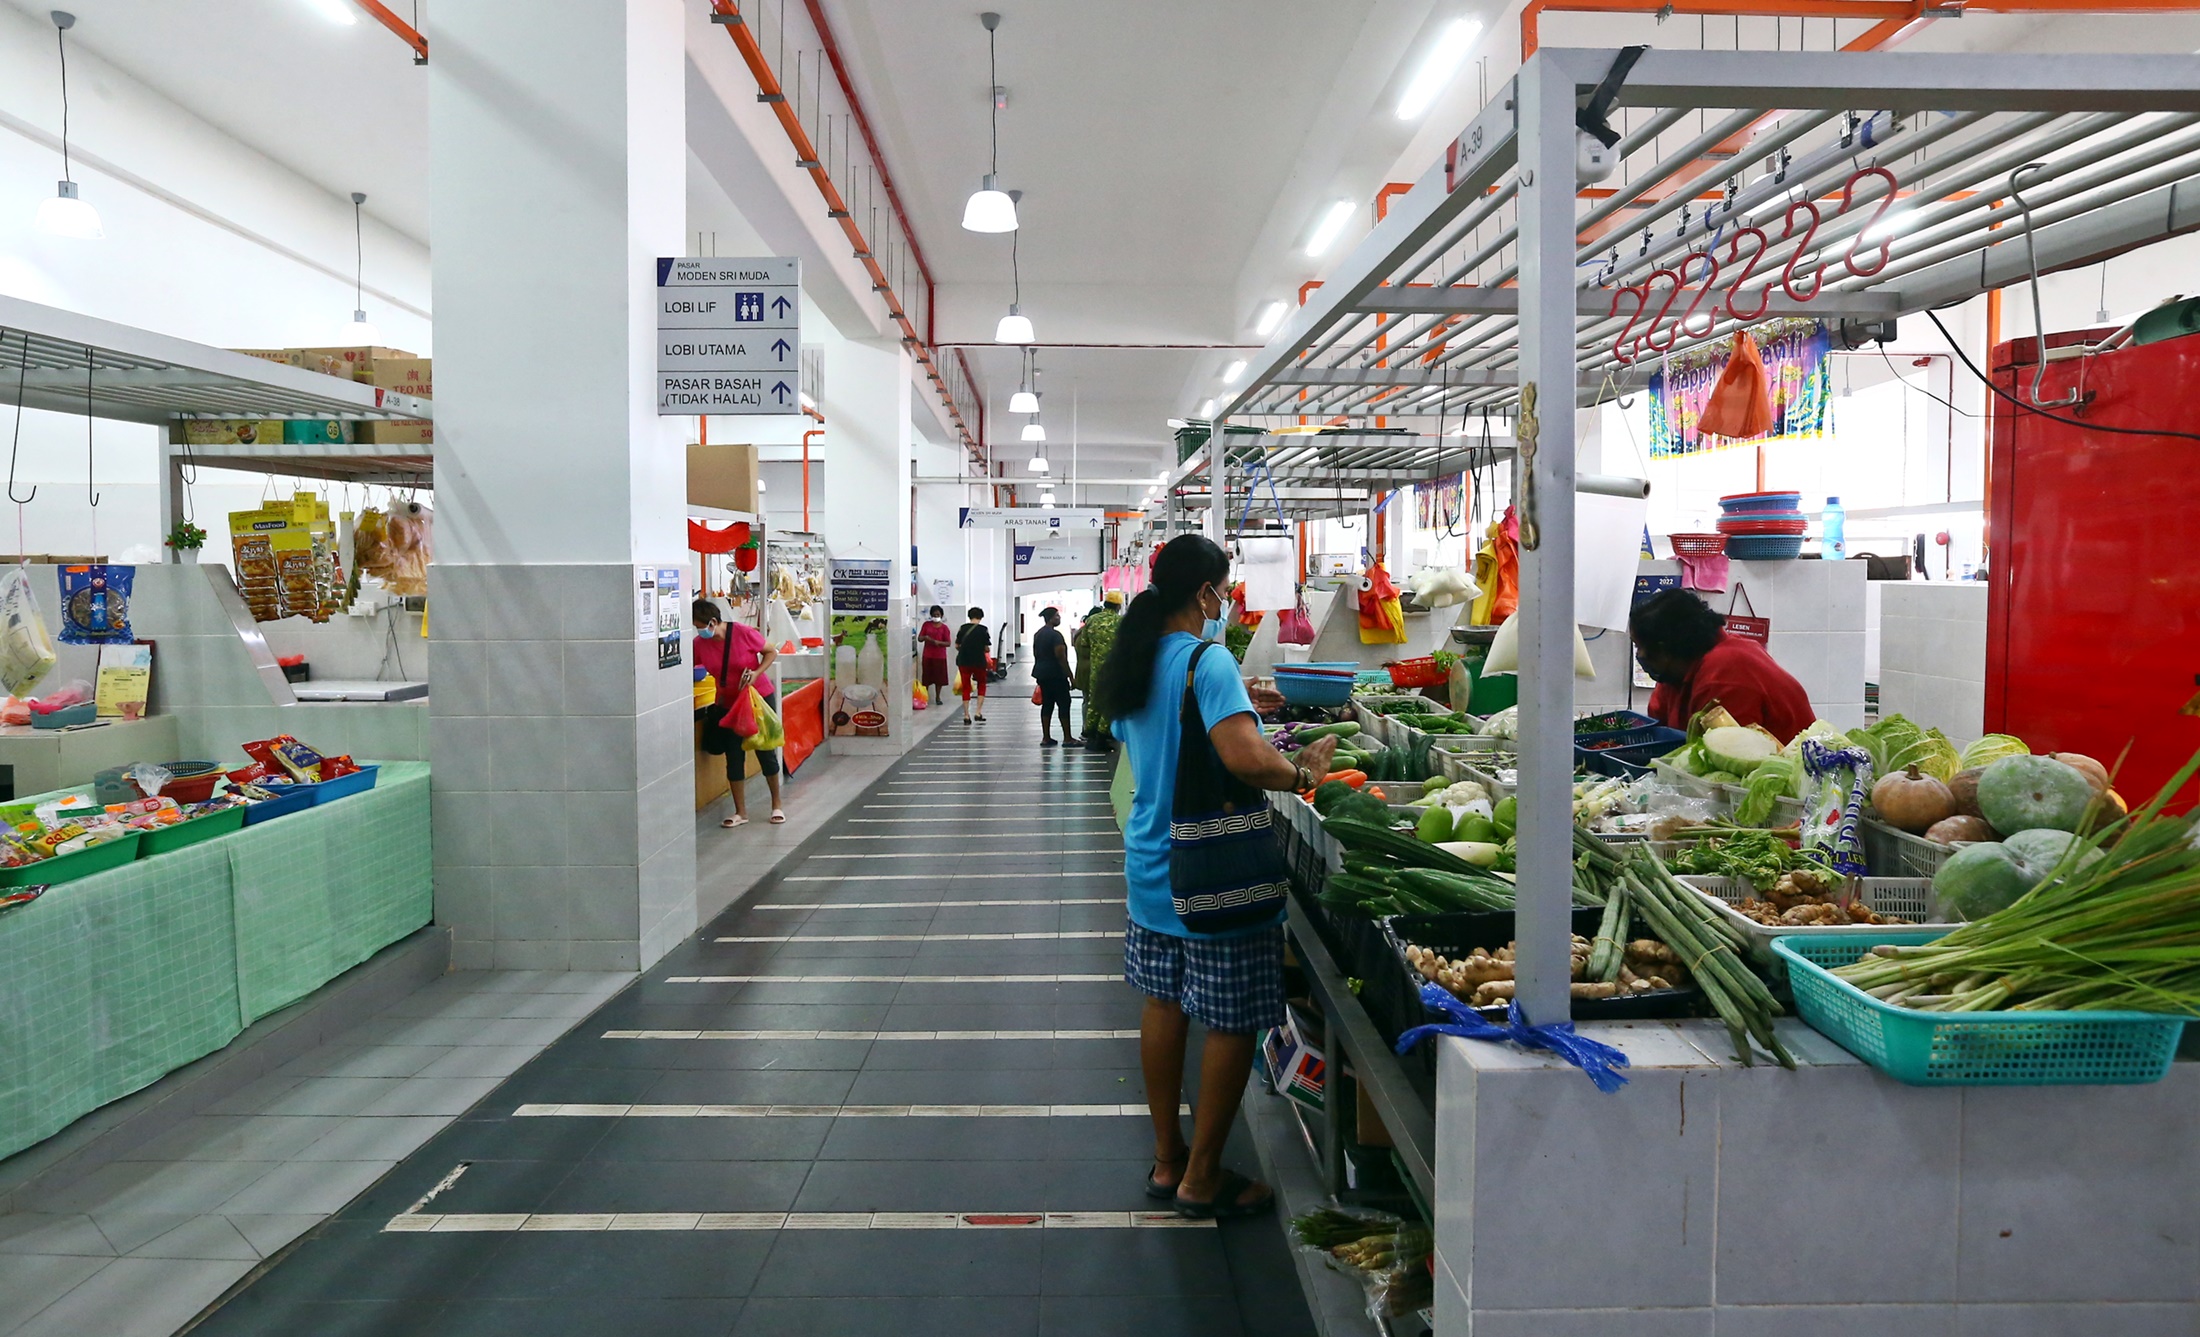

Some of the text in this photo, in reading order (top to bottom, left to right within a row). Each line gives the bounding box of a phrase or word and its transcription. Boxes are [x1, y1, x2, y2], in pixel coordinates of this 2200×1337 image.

[1460, 125, 1483, 167] A-39
[677, 271, 770, 281] MODEN SRI MUDA
[664, 301, 717, 313] LOBI LIF
[665, 344, 747, 356] LOBI UTAMA
[665, 378, 761, 390] PASAR BASAH
[1668, 362, 1717, 396] Happy
[393, 385, 414, 394] TEO
[386, 395, 401, 407] A-38
[665, 393, 761, 407] (TIDAK HALAL)
[253, 521, 285, 530] MasFood
[1050, 518, 1060, 526] GF
[833, 568, 848, 579] CK
[1732, 623, 1751, 631] LESEN
[45, 833, 66, 845] QQ
